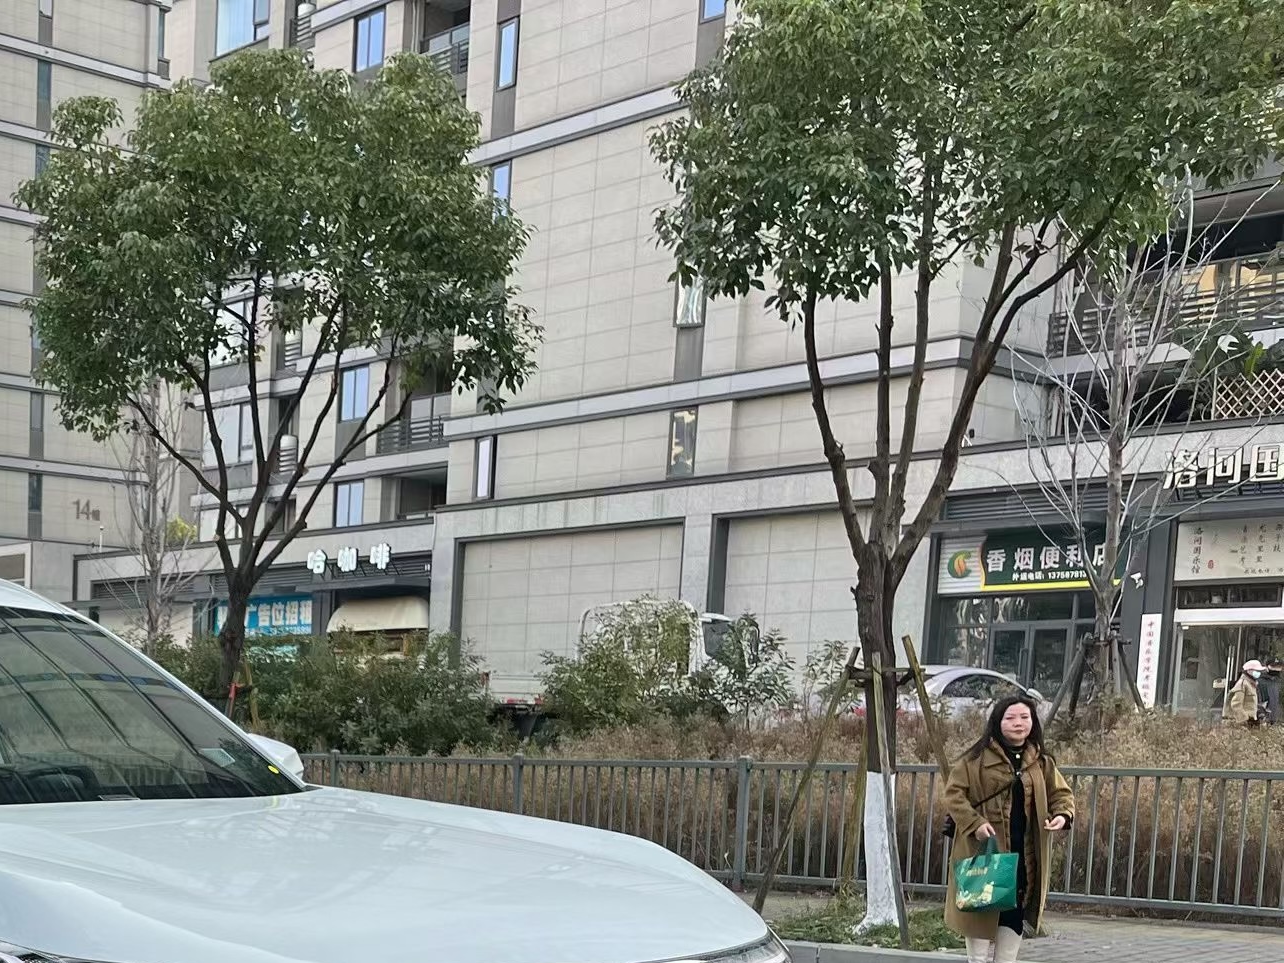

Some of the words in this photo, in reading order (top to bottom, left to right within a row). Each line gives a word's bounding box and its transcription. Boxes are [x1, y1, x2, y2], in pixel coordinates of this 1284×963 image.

[217, 600, 313, 630] 广告位招租
